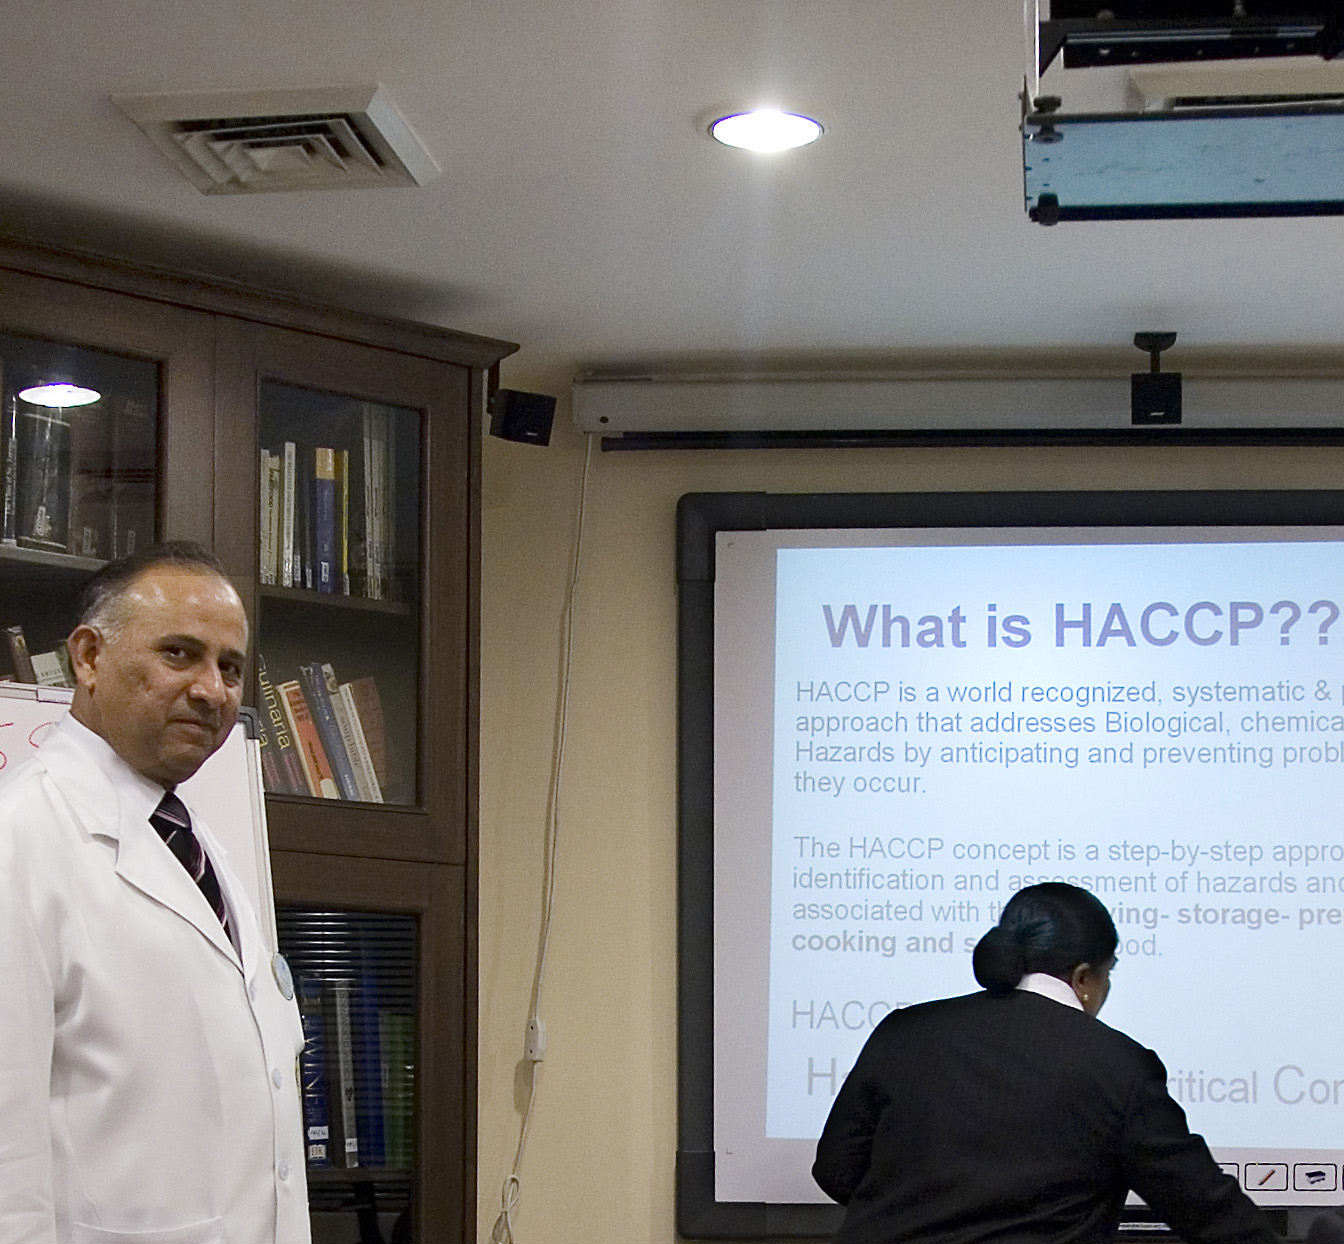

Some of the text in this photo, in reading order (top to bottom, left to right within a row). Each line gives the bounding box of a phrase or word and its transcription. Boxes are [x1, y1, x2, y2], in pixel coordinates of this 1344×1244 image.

[822, 604, 967, 648] What
[988, 604, 1032, 648] is
[797, 681, 890, 702] HACCP
[899, 681, 916, 702] is
[926, 687, 939, 702] a
[947, 681, 1012, 702] world
[1022, 681, 1161, 707] recognized,
[1173, 680, 1305, 707] systematic
[1314, 680, 1331, 701] &
[796, 711, 908, 736] approach
[916, 711, 962, 732] that
[970, 711, 1096, 732] addresses
[1106, 710, 1230, 737] Biological,
[796, 742, 894, 762] Hazards
[905, 741, 932, 768] by
[940, 741, 1078, 768] anticipating
[1088, 742, 1133, 763] and
[1143, 741, 1273, 768] preventing
[794, 771, 925, 797] they occur.
[794, 836, 840, 858] The
[850, 837, 944, 859] HACCP
[953, 840, 1050, 866] concept
[1058, 839, 1076, 861] is
[1085, 845, 1099, 861] a
[1108, 839, 1263, 867] step-by-step
[794, 867, 944, 890] identification
[954, 869, 999, 891] and
[1165, 871, 1191, 892] of
[1197, 871, 1297, 893] hazards
[793, 899, 923, 921] associated
[931, 900, 979, 921] with
[1178, 903, 1290, 930] storage-
[792, 930, 896, 958] cooking
[906, 931, 953, 953] and
[793, 1000, 910, 1030] HACC
